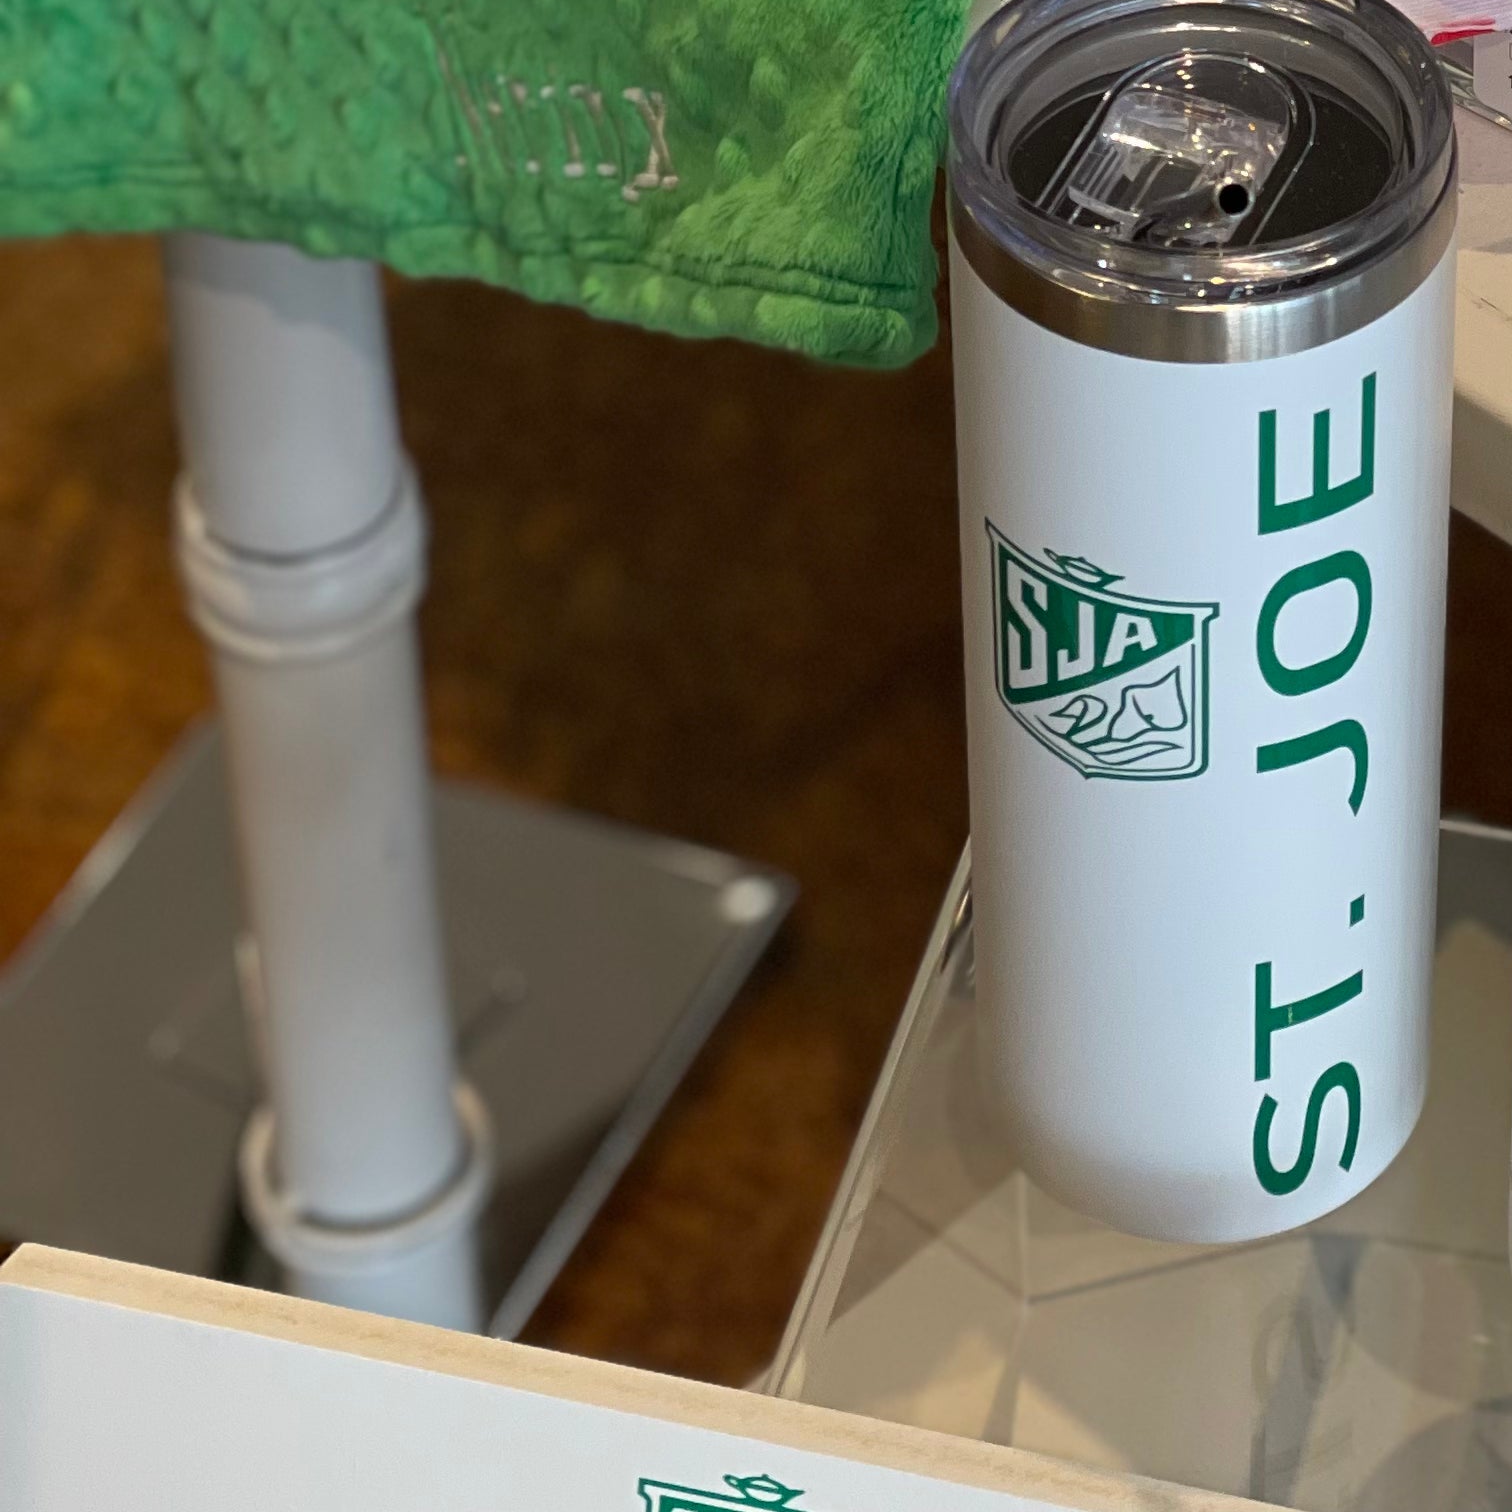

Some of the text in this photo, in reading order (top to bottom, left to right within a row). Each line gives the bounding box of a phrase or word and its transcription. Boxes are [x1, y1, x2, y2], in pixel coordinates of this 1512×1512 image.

[1004, 563, 1159, 691] SJA
[1251, 370, 1378, 1198] ST. JOE
